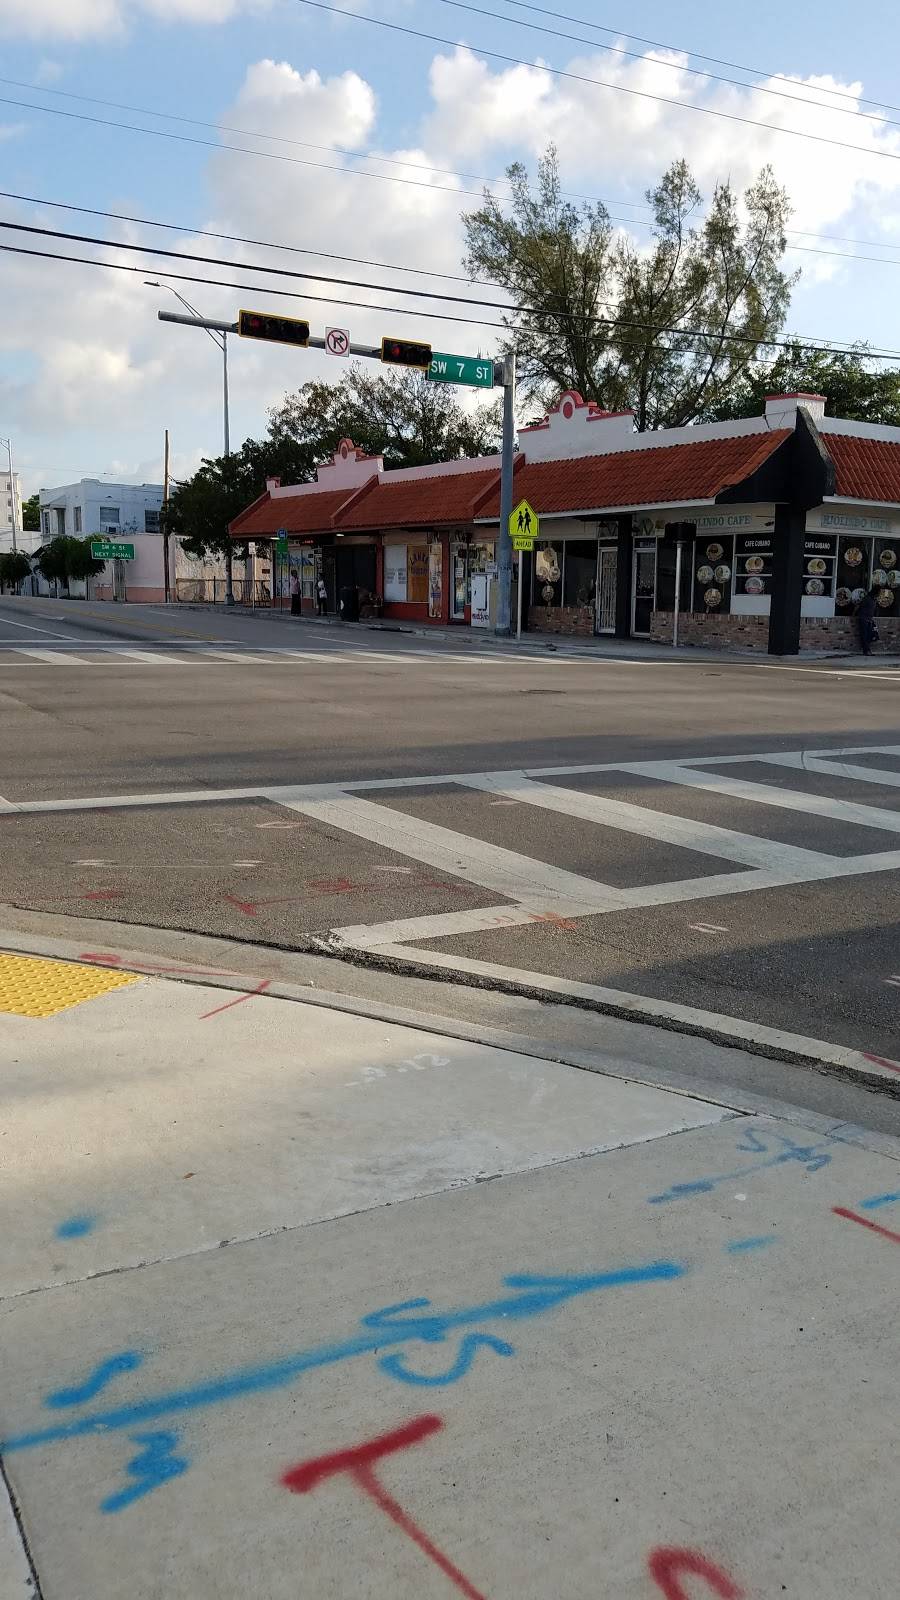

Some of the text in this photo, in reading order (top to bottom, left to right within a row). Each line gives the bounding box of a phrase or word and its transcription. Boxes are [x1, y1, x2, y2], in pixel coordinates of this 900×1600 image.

[431, 360, 489, 380] SW 7 ST
[728, 515, 752, 526] CAFE
[516, 539, 532, 548] AHEAD
